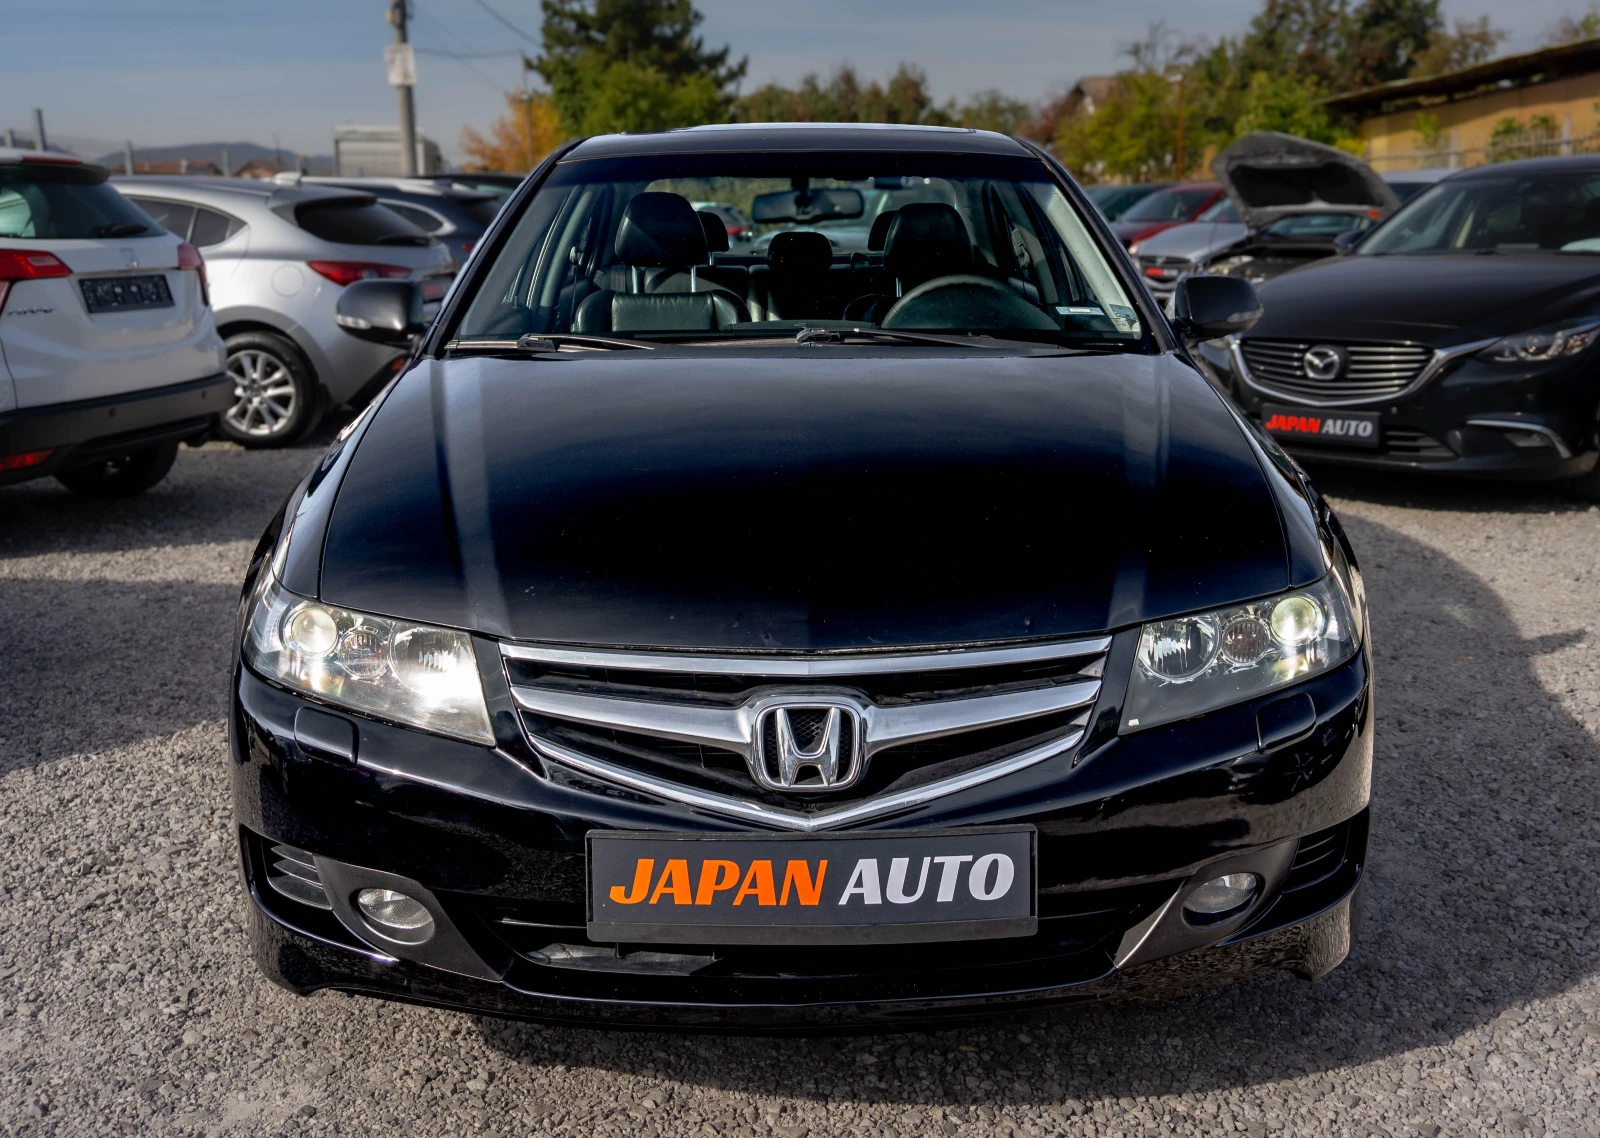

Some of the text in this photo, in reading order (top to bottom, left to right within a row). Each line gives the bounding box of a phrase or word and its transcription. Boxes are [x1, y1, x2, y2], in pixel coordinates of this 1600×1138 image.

[1265, 414, 1373, 437] JAPAN AUTO
[609, 853, 1015, 906] JAPAN AUTO
